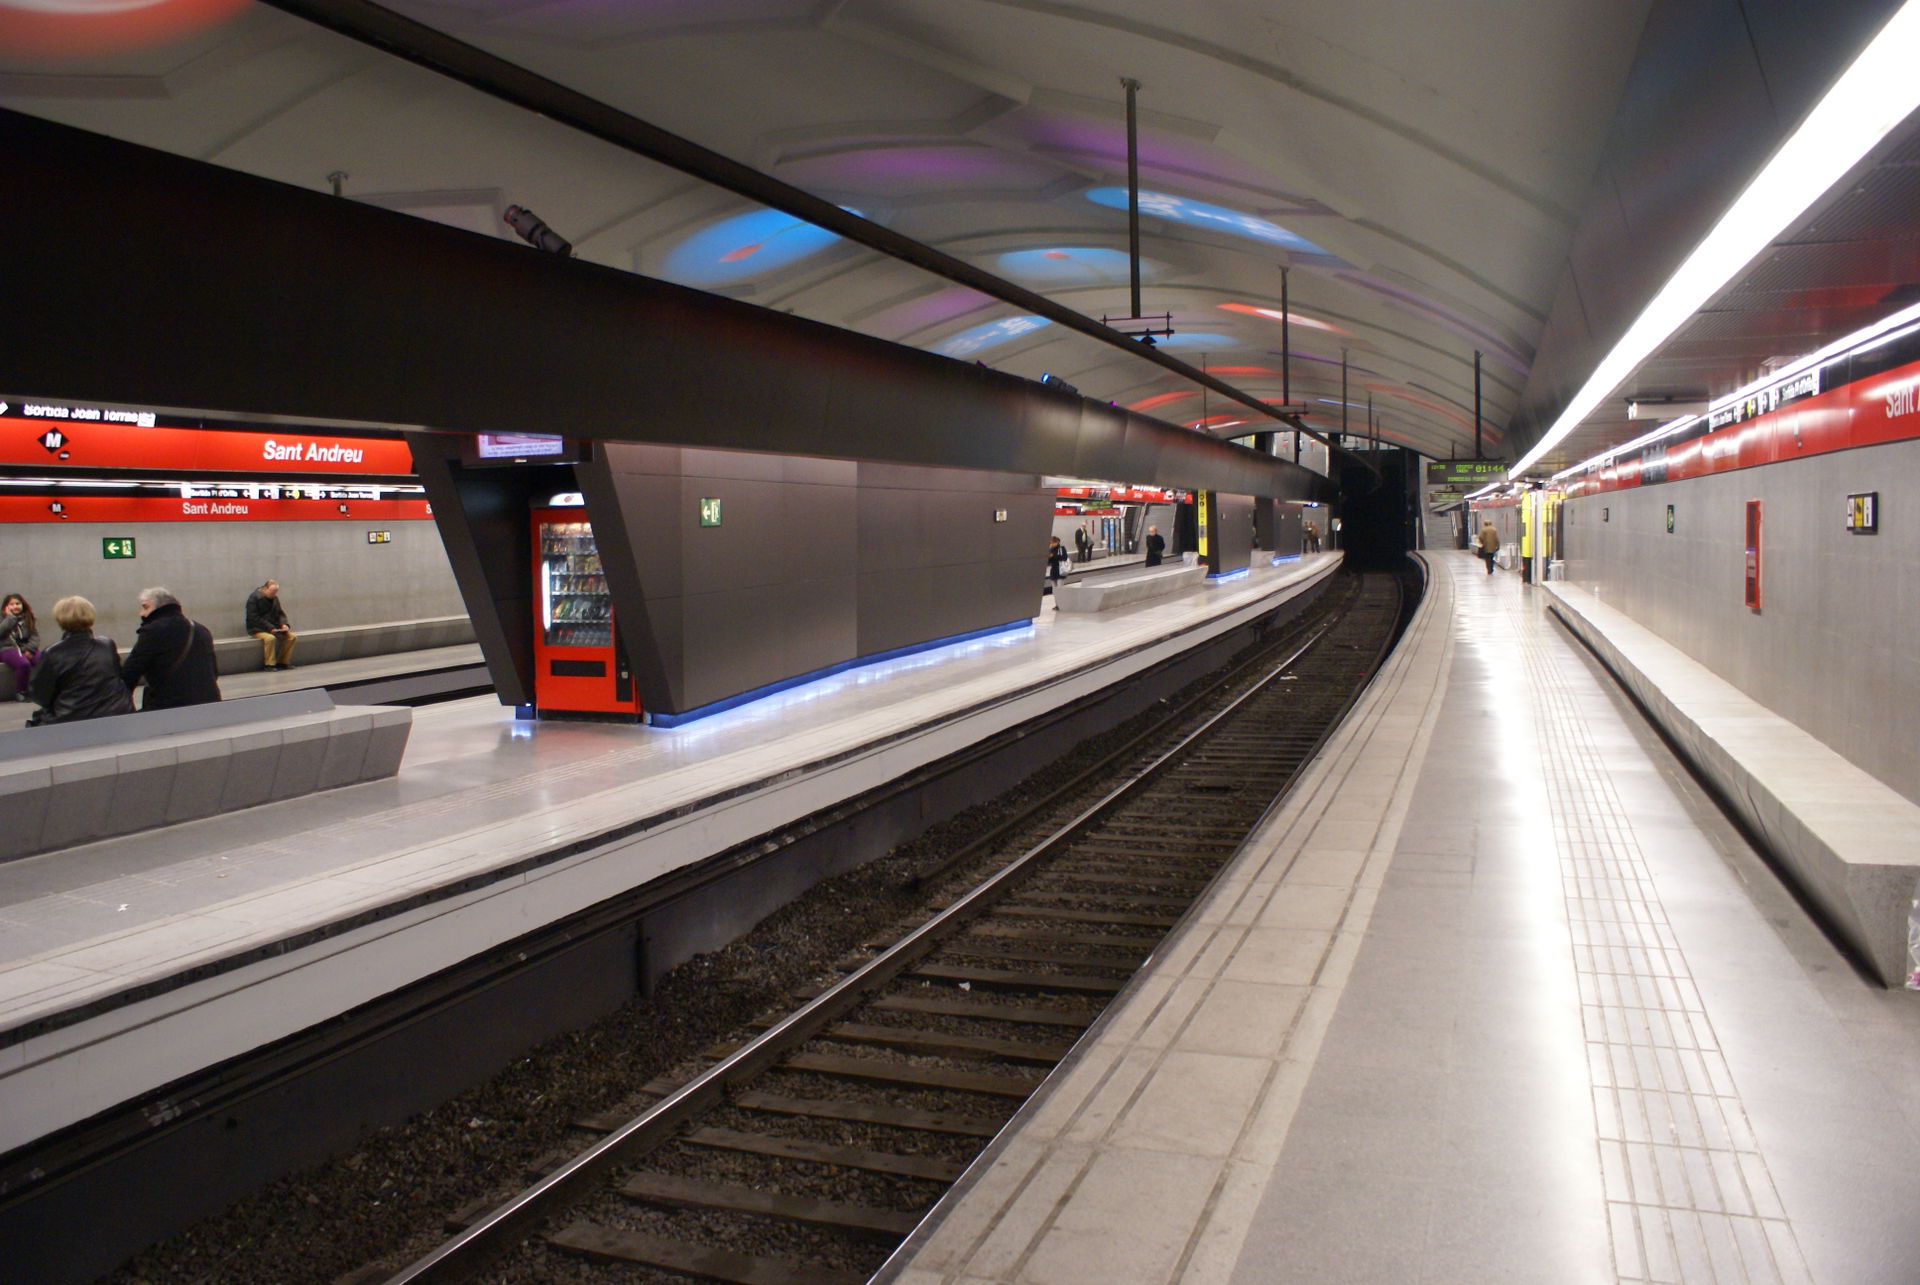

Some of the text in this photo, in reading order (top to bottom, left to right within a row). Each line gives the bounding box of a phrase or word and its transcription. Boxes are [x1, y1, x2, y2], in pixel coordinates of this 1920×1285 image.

[263, 439, 364, 463] Sant Andreu
[1475, 464, 1505, 473] 01:44
[182, 502, 249, 515] Sant Andreu
